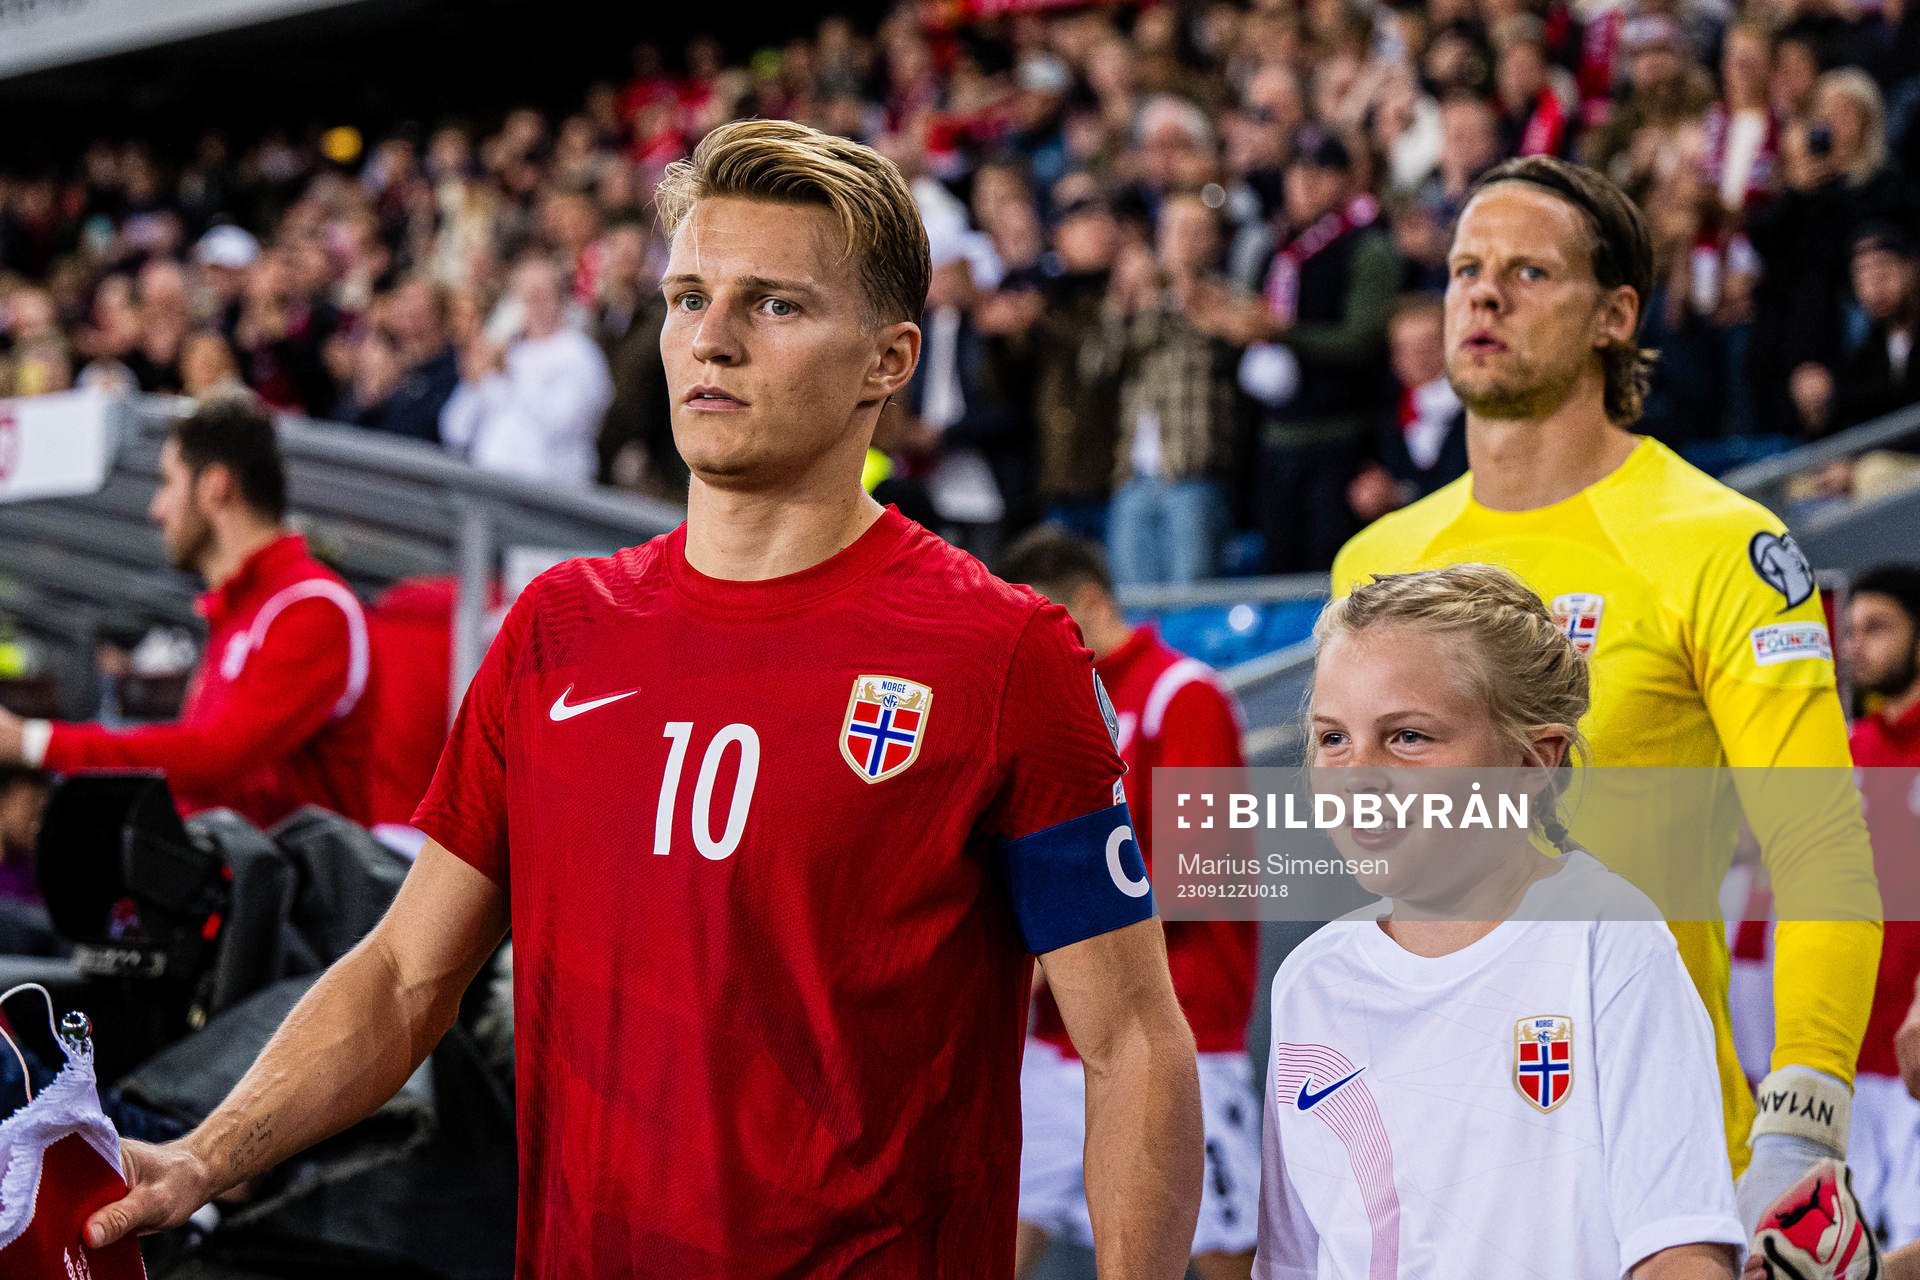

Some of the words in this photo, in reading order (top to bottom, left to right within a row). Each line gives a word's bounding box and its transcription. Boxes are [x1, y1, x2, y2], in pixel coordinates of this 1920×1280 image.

[881, 681, 907, 693] NORGE
[653, 721, 760, 860] 10
[1105, 825, 1150, 898] C
